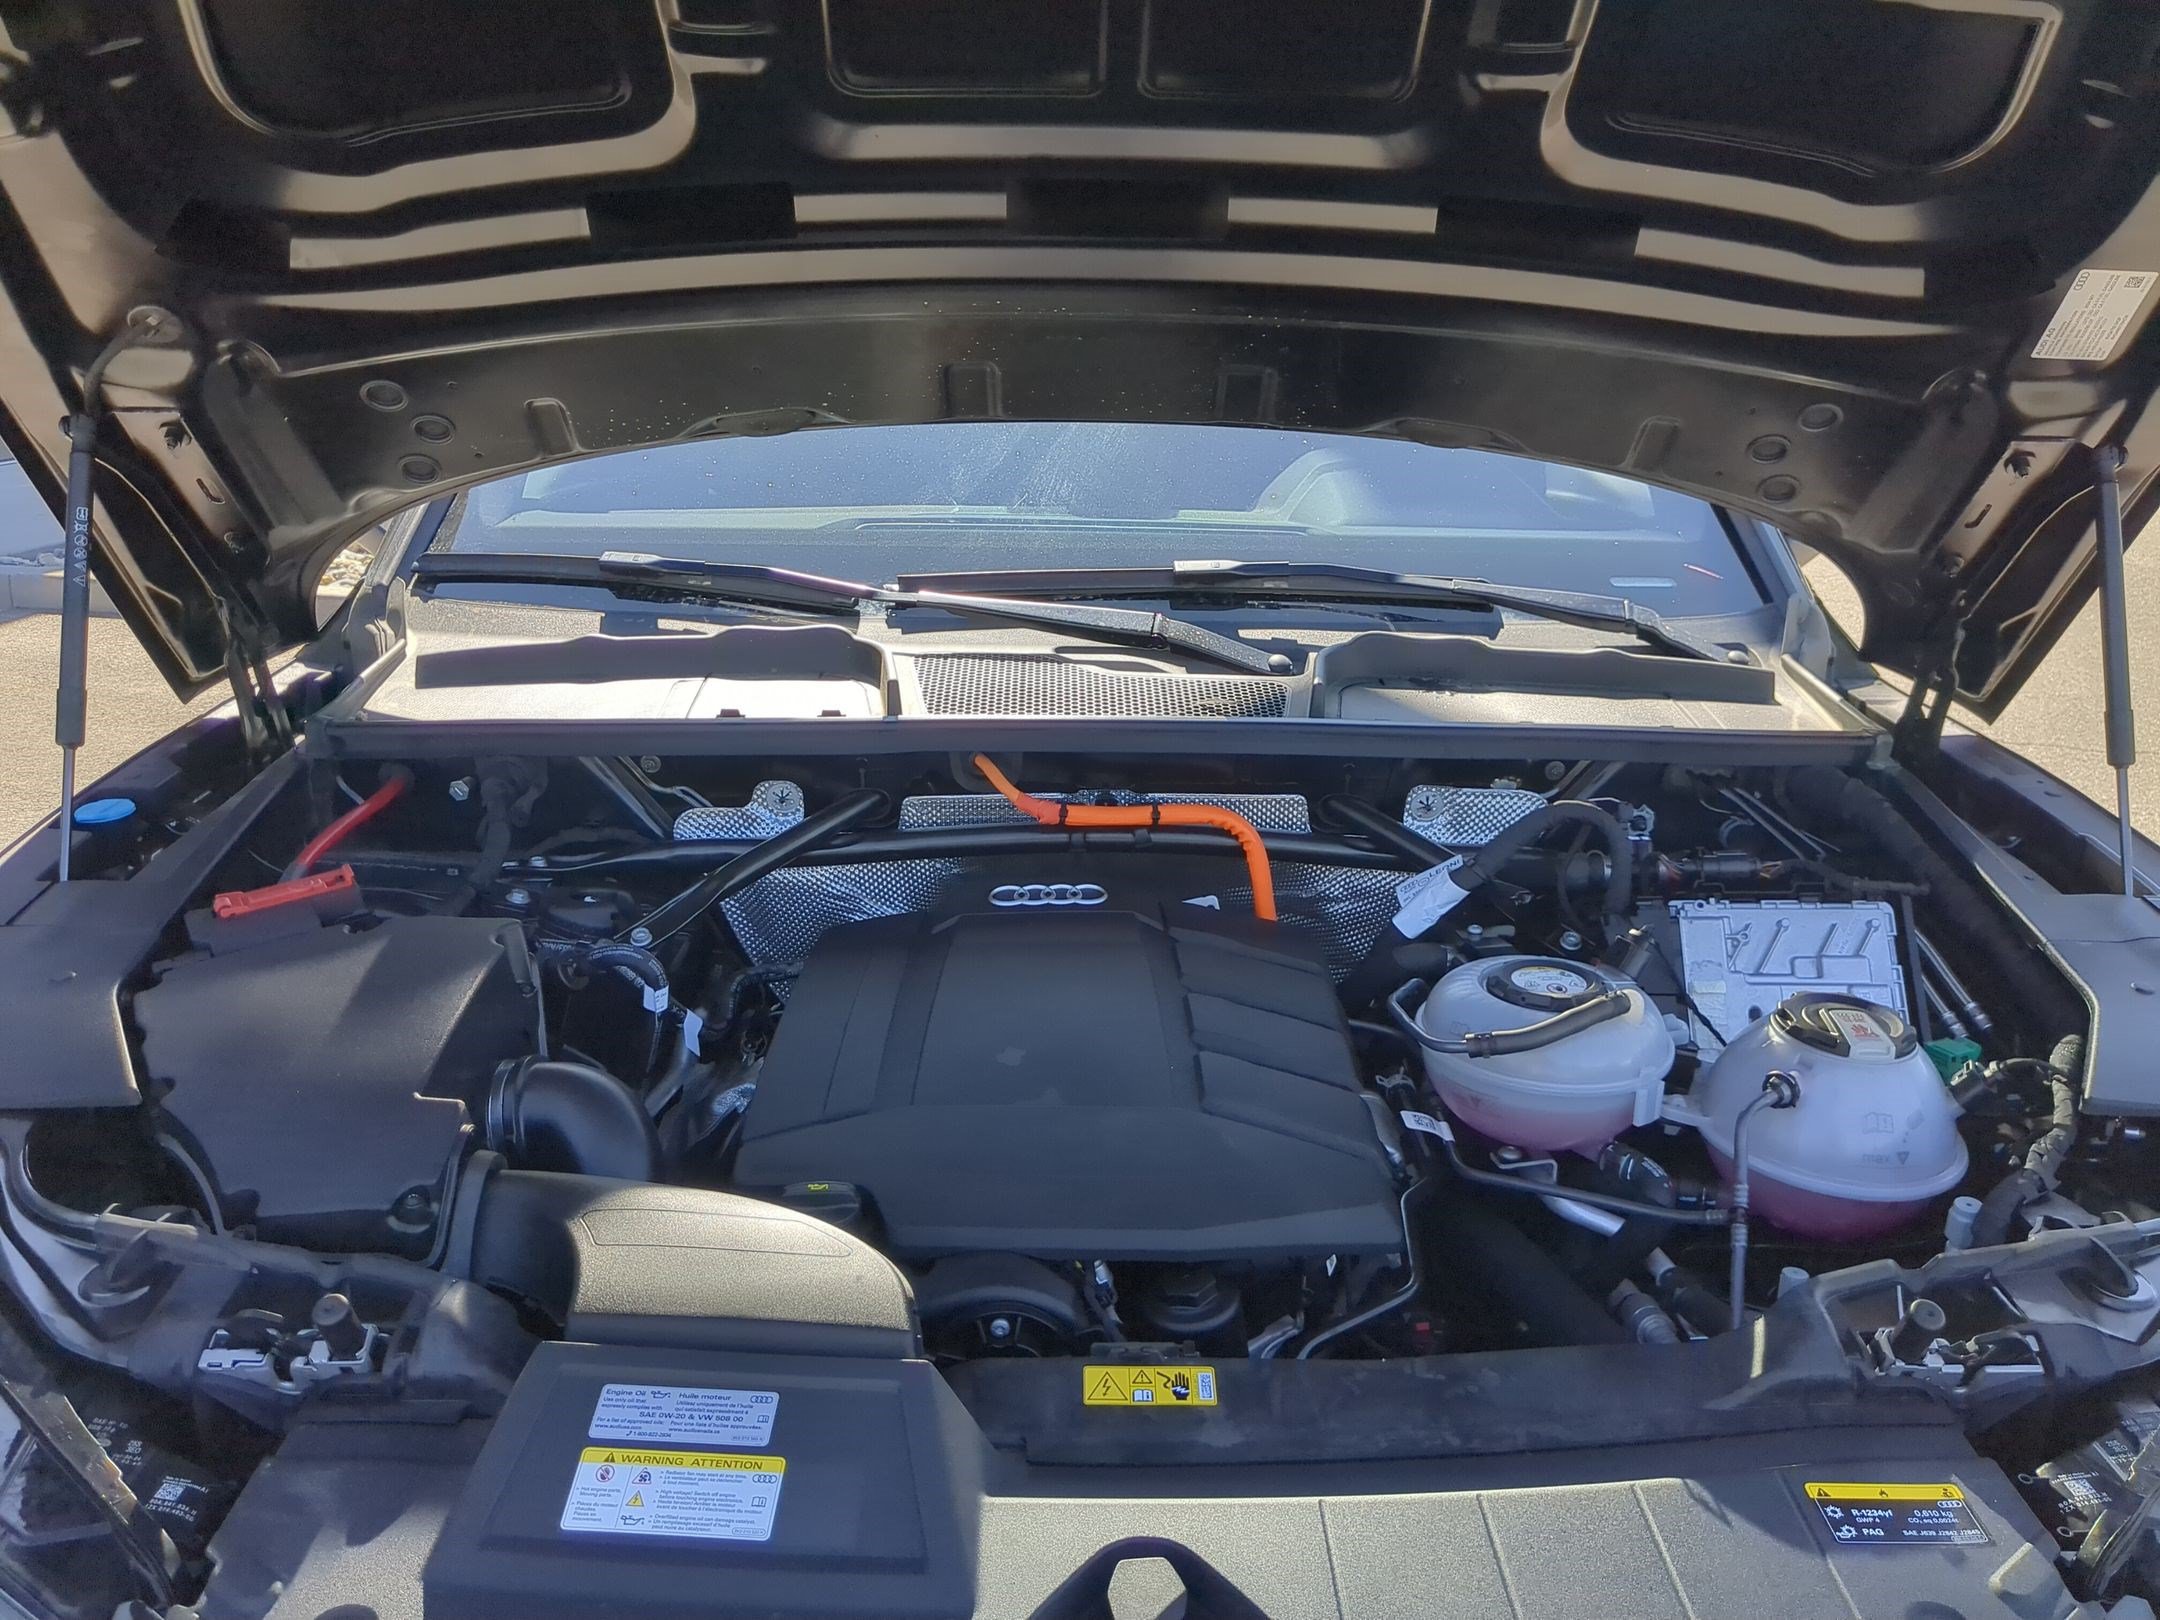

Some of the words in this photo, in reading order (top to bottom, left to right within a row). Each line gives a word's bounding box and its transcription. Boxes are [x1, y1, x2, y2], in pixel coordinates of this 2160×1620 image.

[1429, 859, 1460, 878] LEONI
[605, 1388, 633, 1396] Engine
[619, 1453, 685, 1466] WARNING
[689, 1457, 763, 1470] ATTENTION
[1940, 1509, 1954, 1518] kg
[1862, 1528, 1885, 1536] PAG
